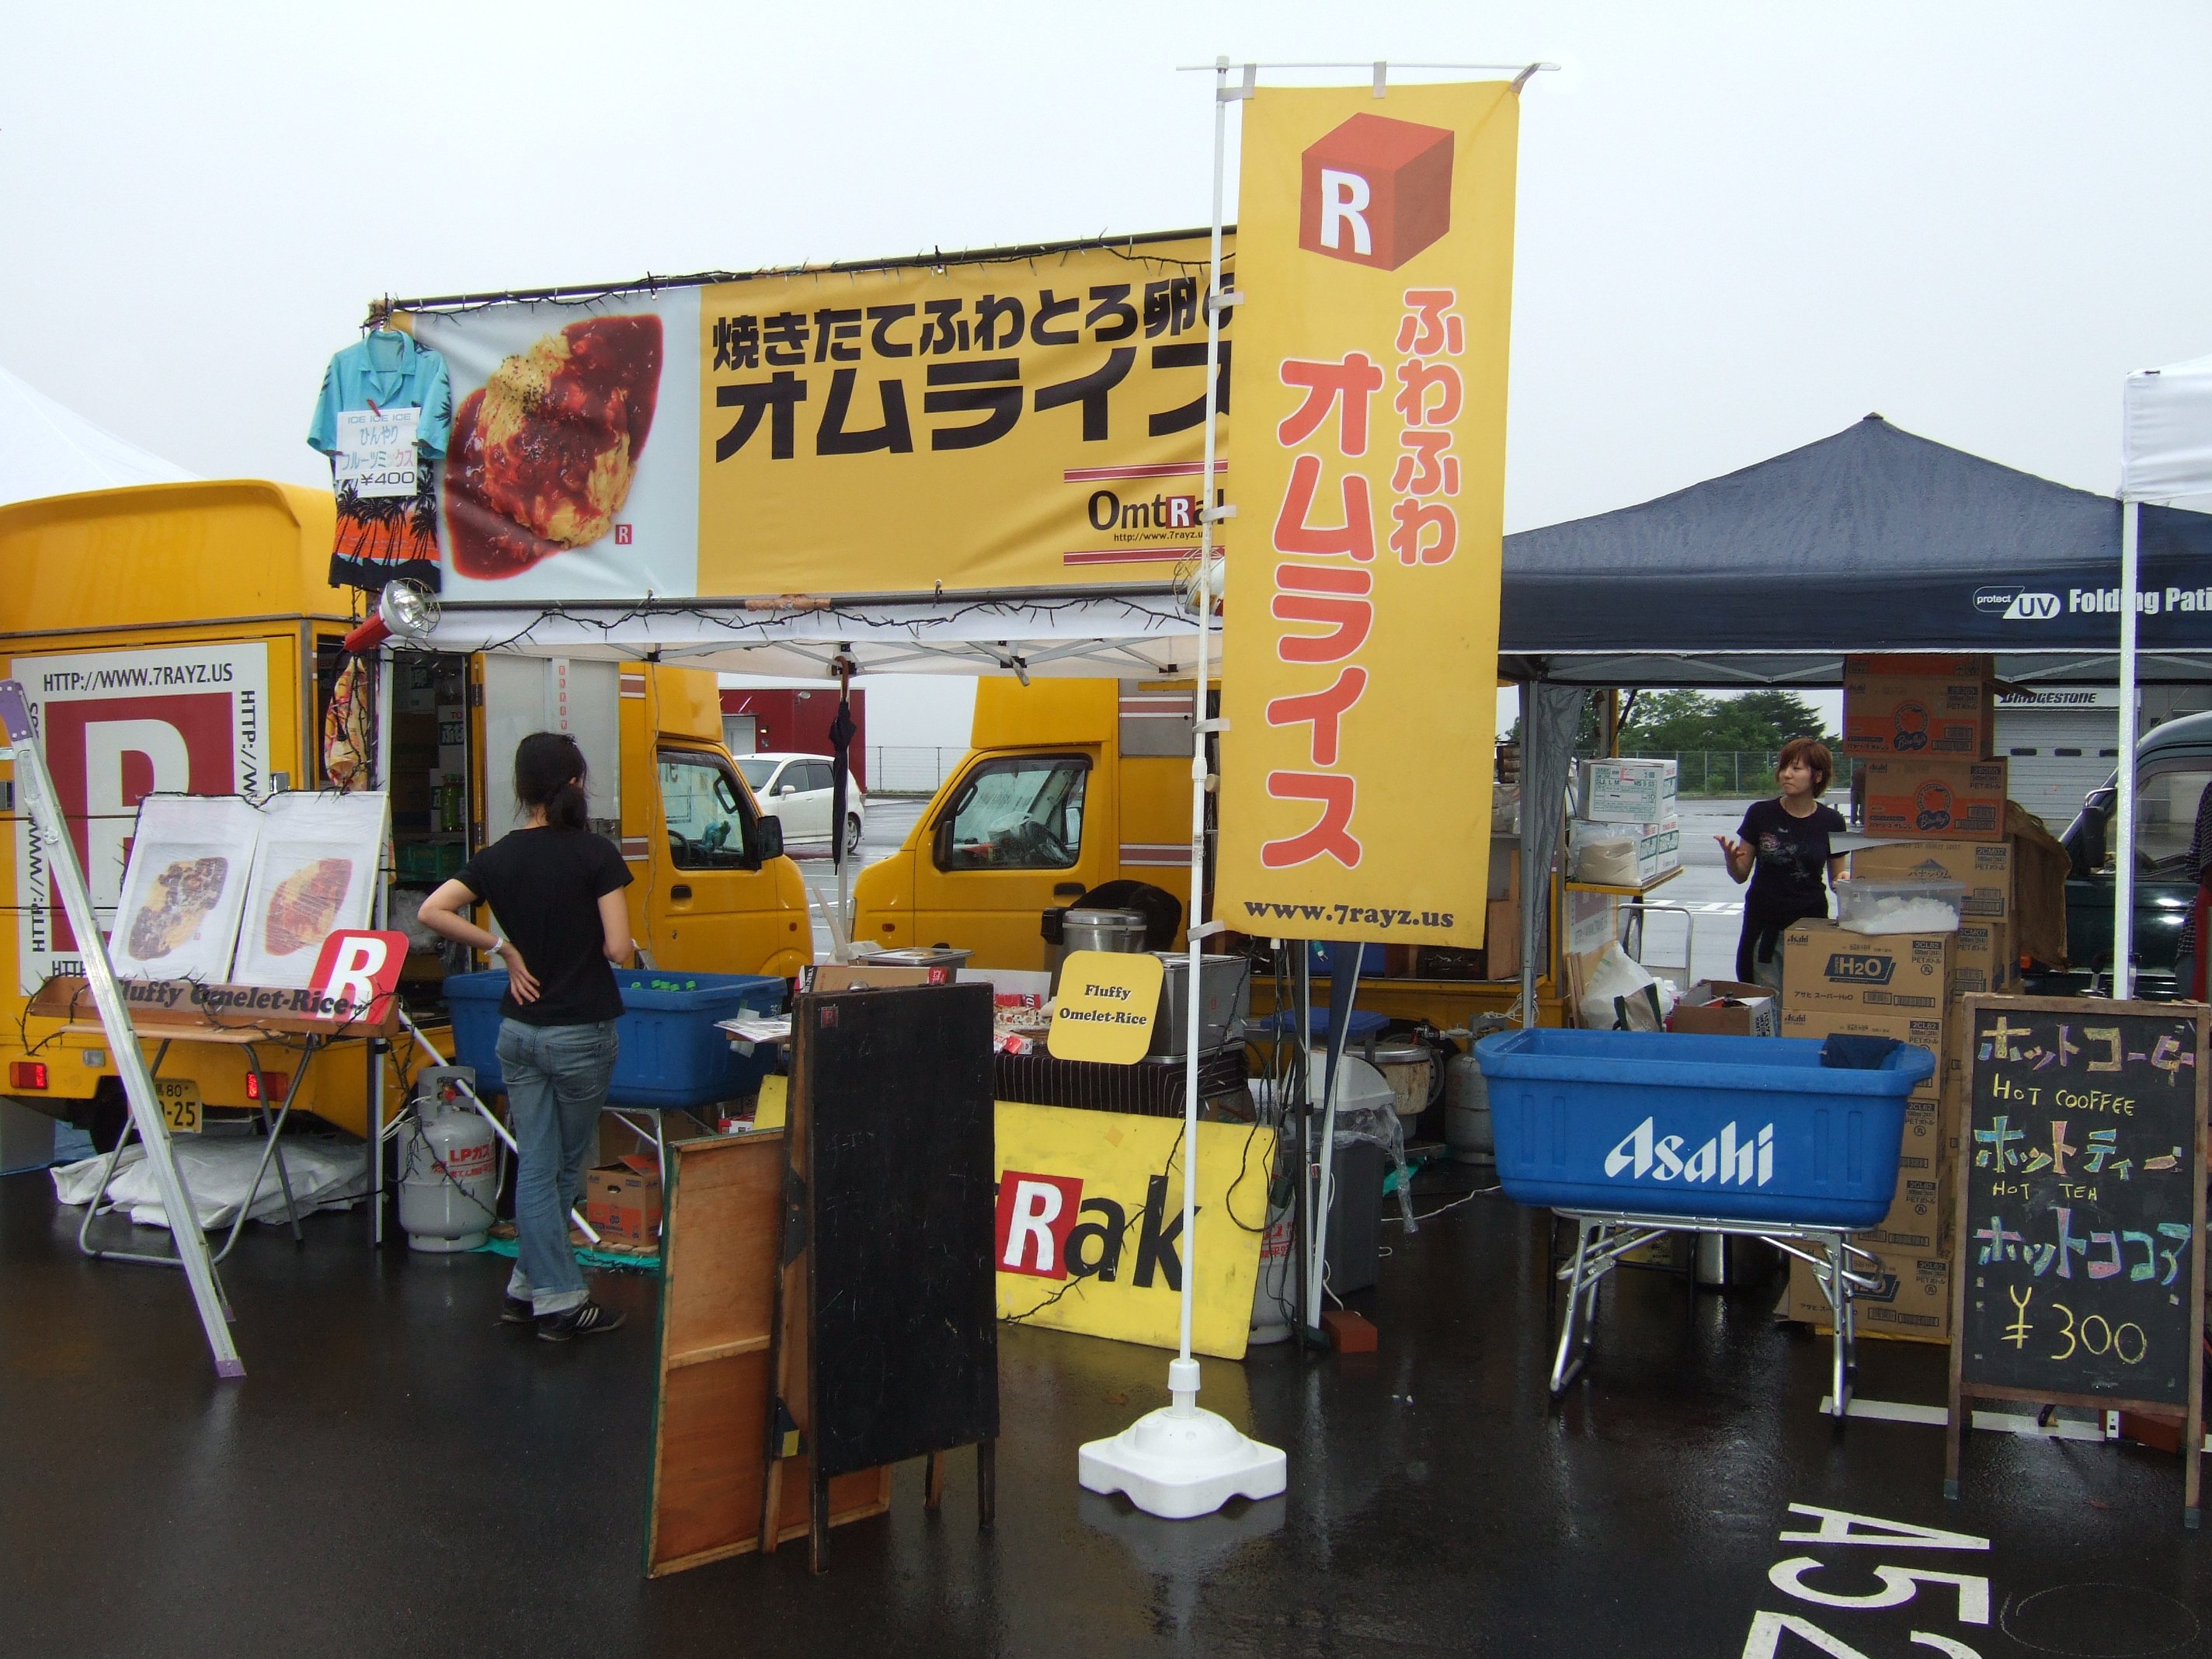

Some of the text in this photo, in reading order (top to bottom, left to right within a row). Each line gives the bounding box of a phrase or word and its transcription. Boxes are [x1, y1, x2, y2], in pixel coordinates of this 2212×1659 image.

[1320, 169, 1372, 256] R
[348, 416, 367, 424] ICE
[393, 412, 412, 422] ICE
[1390, 288, 1464, 566] ふわふわ
[360, 425, 398, 446] ひんやり
[360, 471, 415, 485] ¥400
[1114, 530, 1205, 543] http://www.7rayz.u
[1261, 353, 1385, 869] オムライス
[1977, 594, 2012, 605] protect
[2019, 596, 2056, 617] UV
[2068, 588, 2160, 616] Foldng
[43, 663, 233, 692] HTTP://WWW.7RAYZ.US
[1244, 901, 1454, 928] www.7rayz.us
[1787, 934, 1809, 944] Asahi
[118, 980, 183, 1008] luffy
[1084, 984, 1132, 1001] Fluffy
[1059, 1007, 1147, 1025] Omelet-Rice
[1784, 1014, 1807, 1023] Asahi
[1978, 1016, 2195, 1072] ホットコーヒー
[166, 1084, 182, 1097] 80
[2055, 1089, 2136, 1117] COOFFEE
[1605, 1116, 1773, 1187] Asahi
[1974, 1115, 2178, 1181] ホットティー
[995, 1174, 1203, 1292] Rak
[1973, 1207, 2193, 1286] ホットココア
